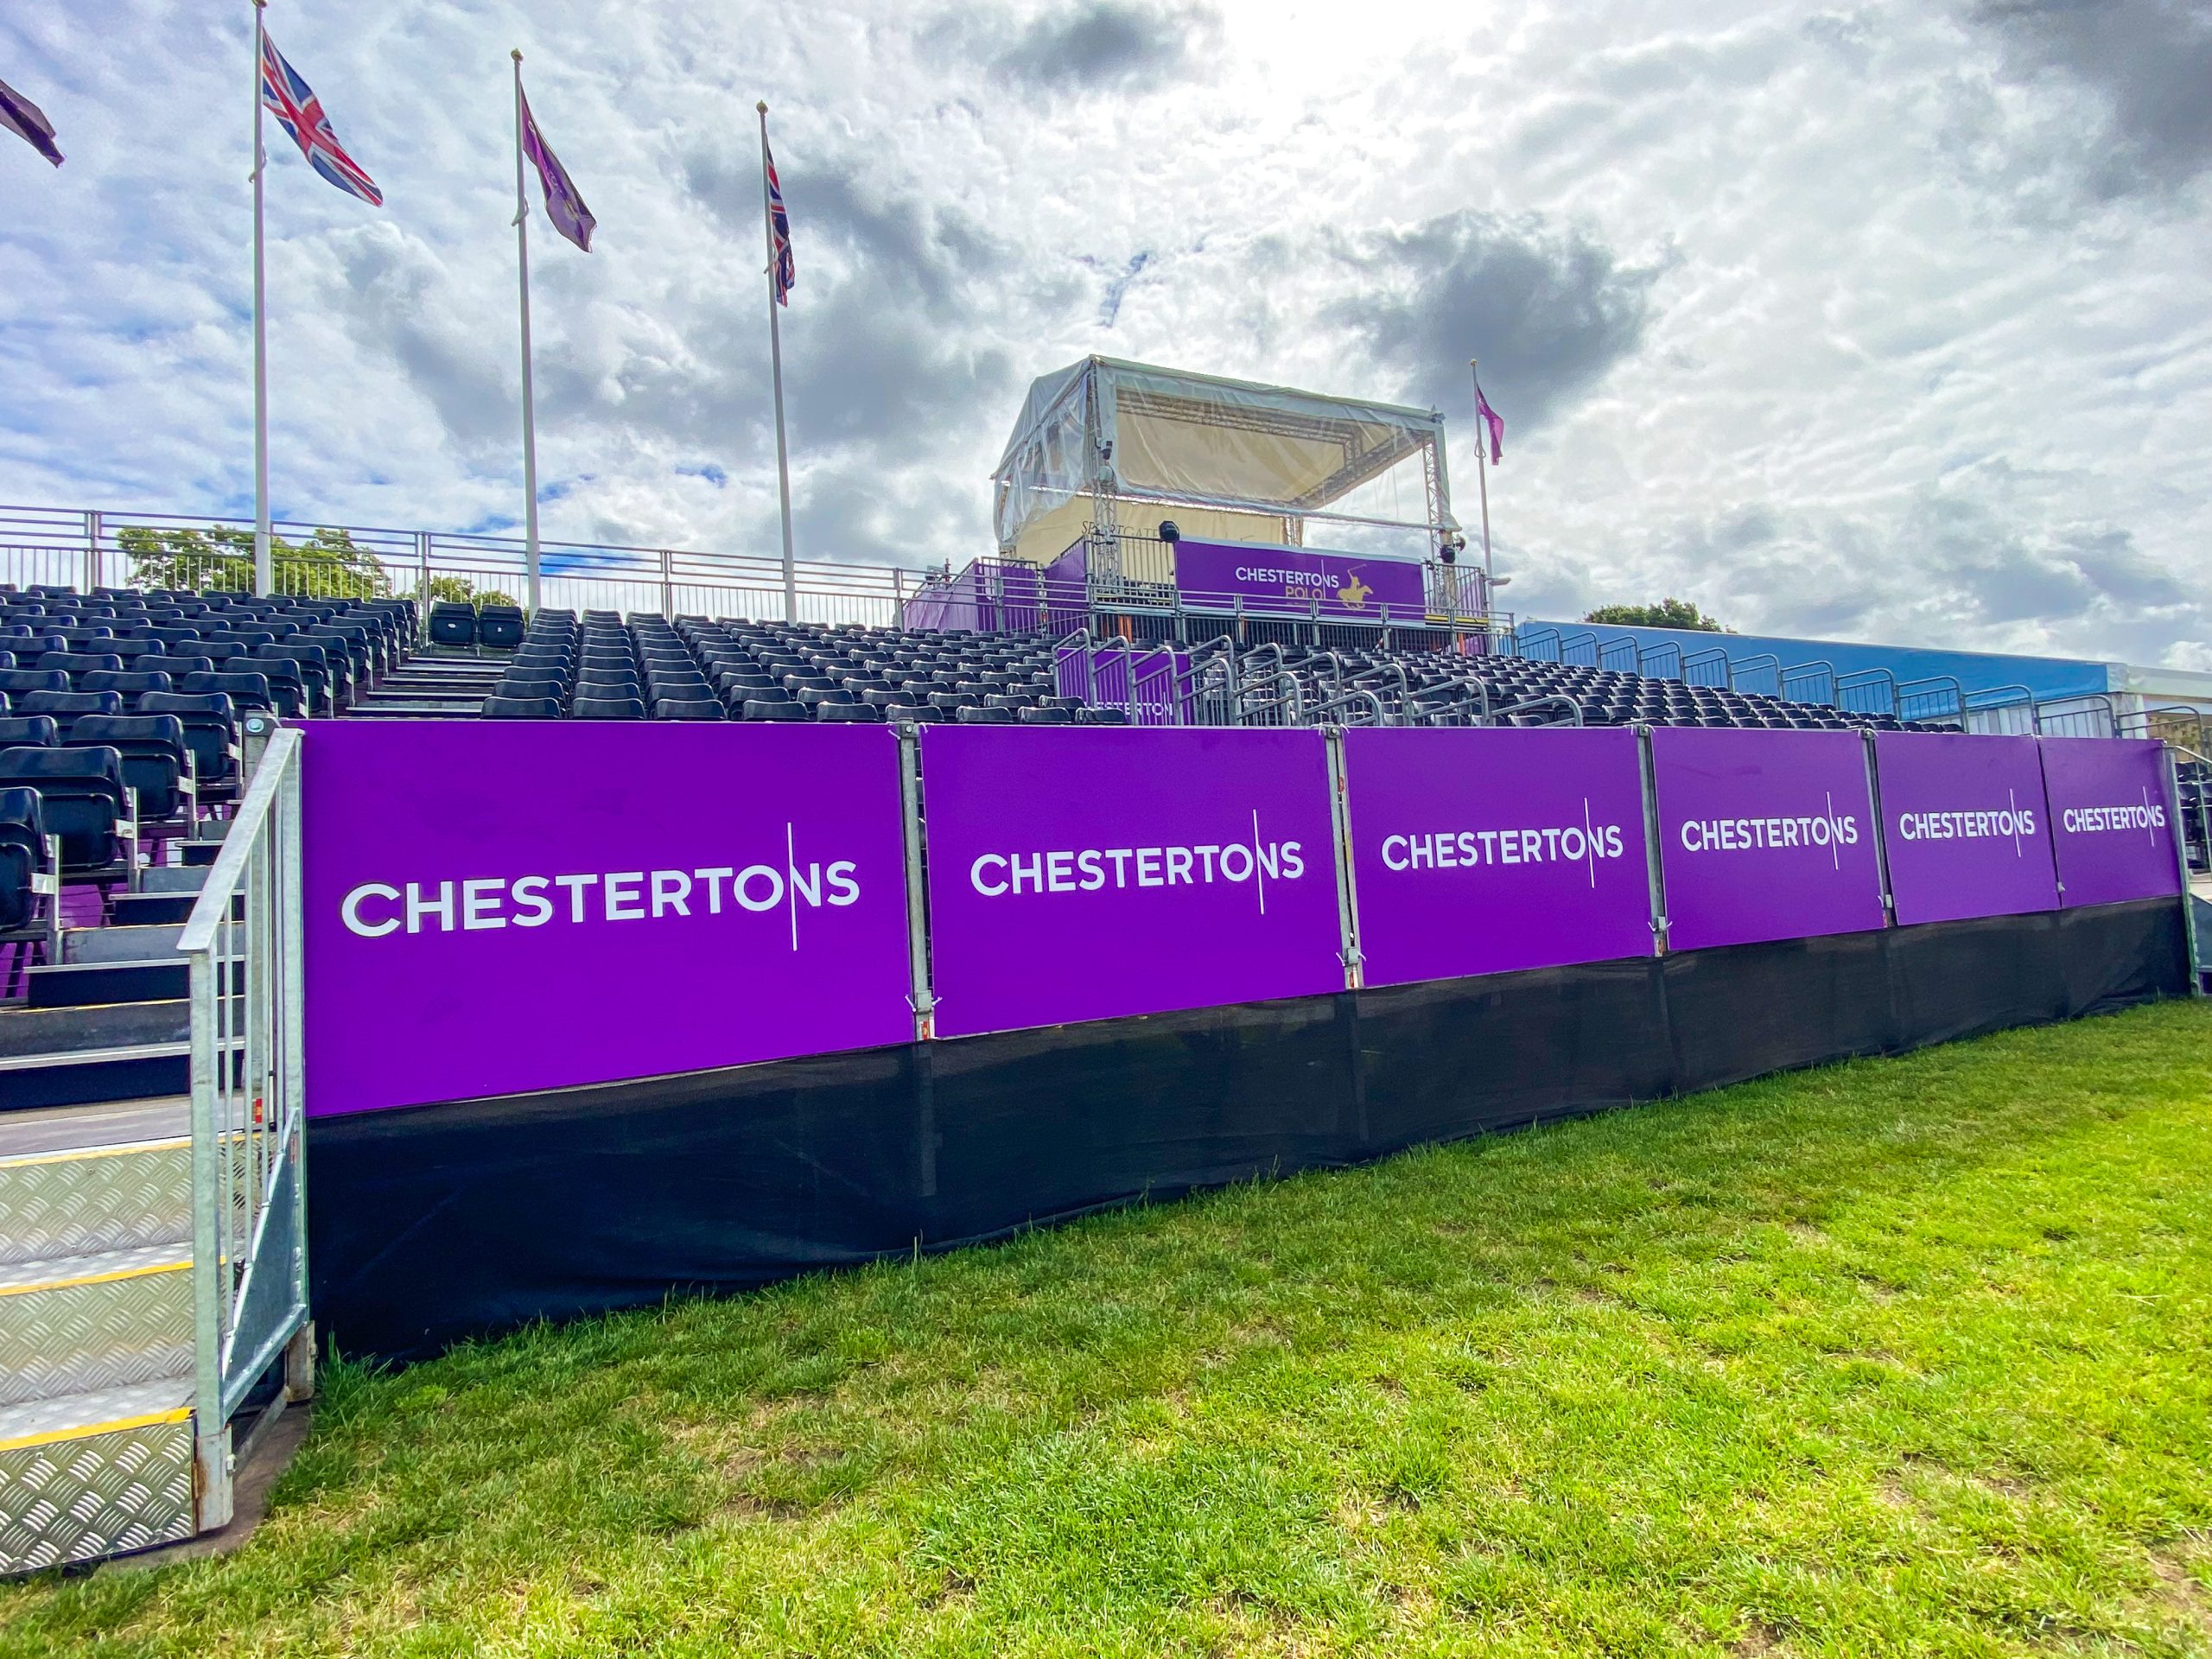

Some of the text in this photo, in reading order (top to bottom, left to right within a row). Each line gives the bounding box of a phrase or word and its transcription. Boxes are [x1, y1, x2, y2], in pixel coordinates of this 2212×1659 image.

[1081, 520, 1160, 537] SPRTGATE
[1285, 586, 1323, 600] POLO
[341, 822, 860, 951] CHESTERTONS
